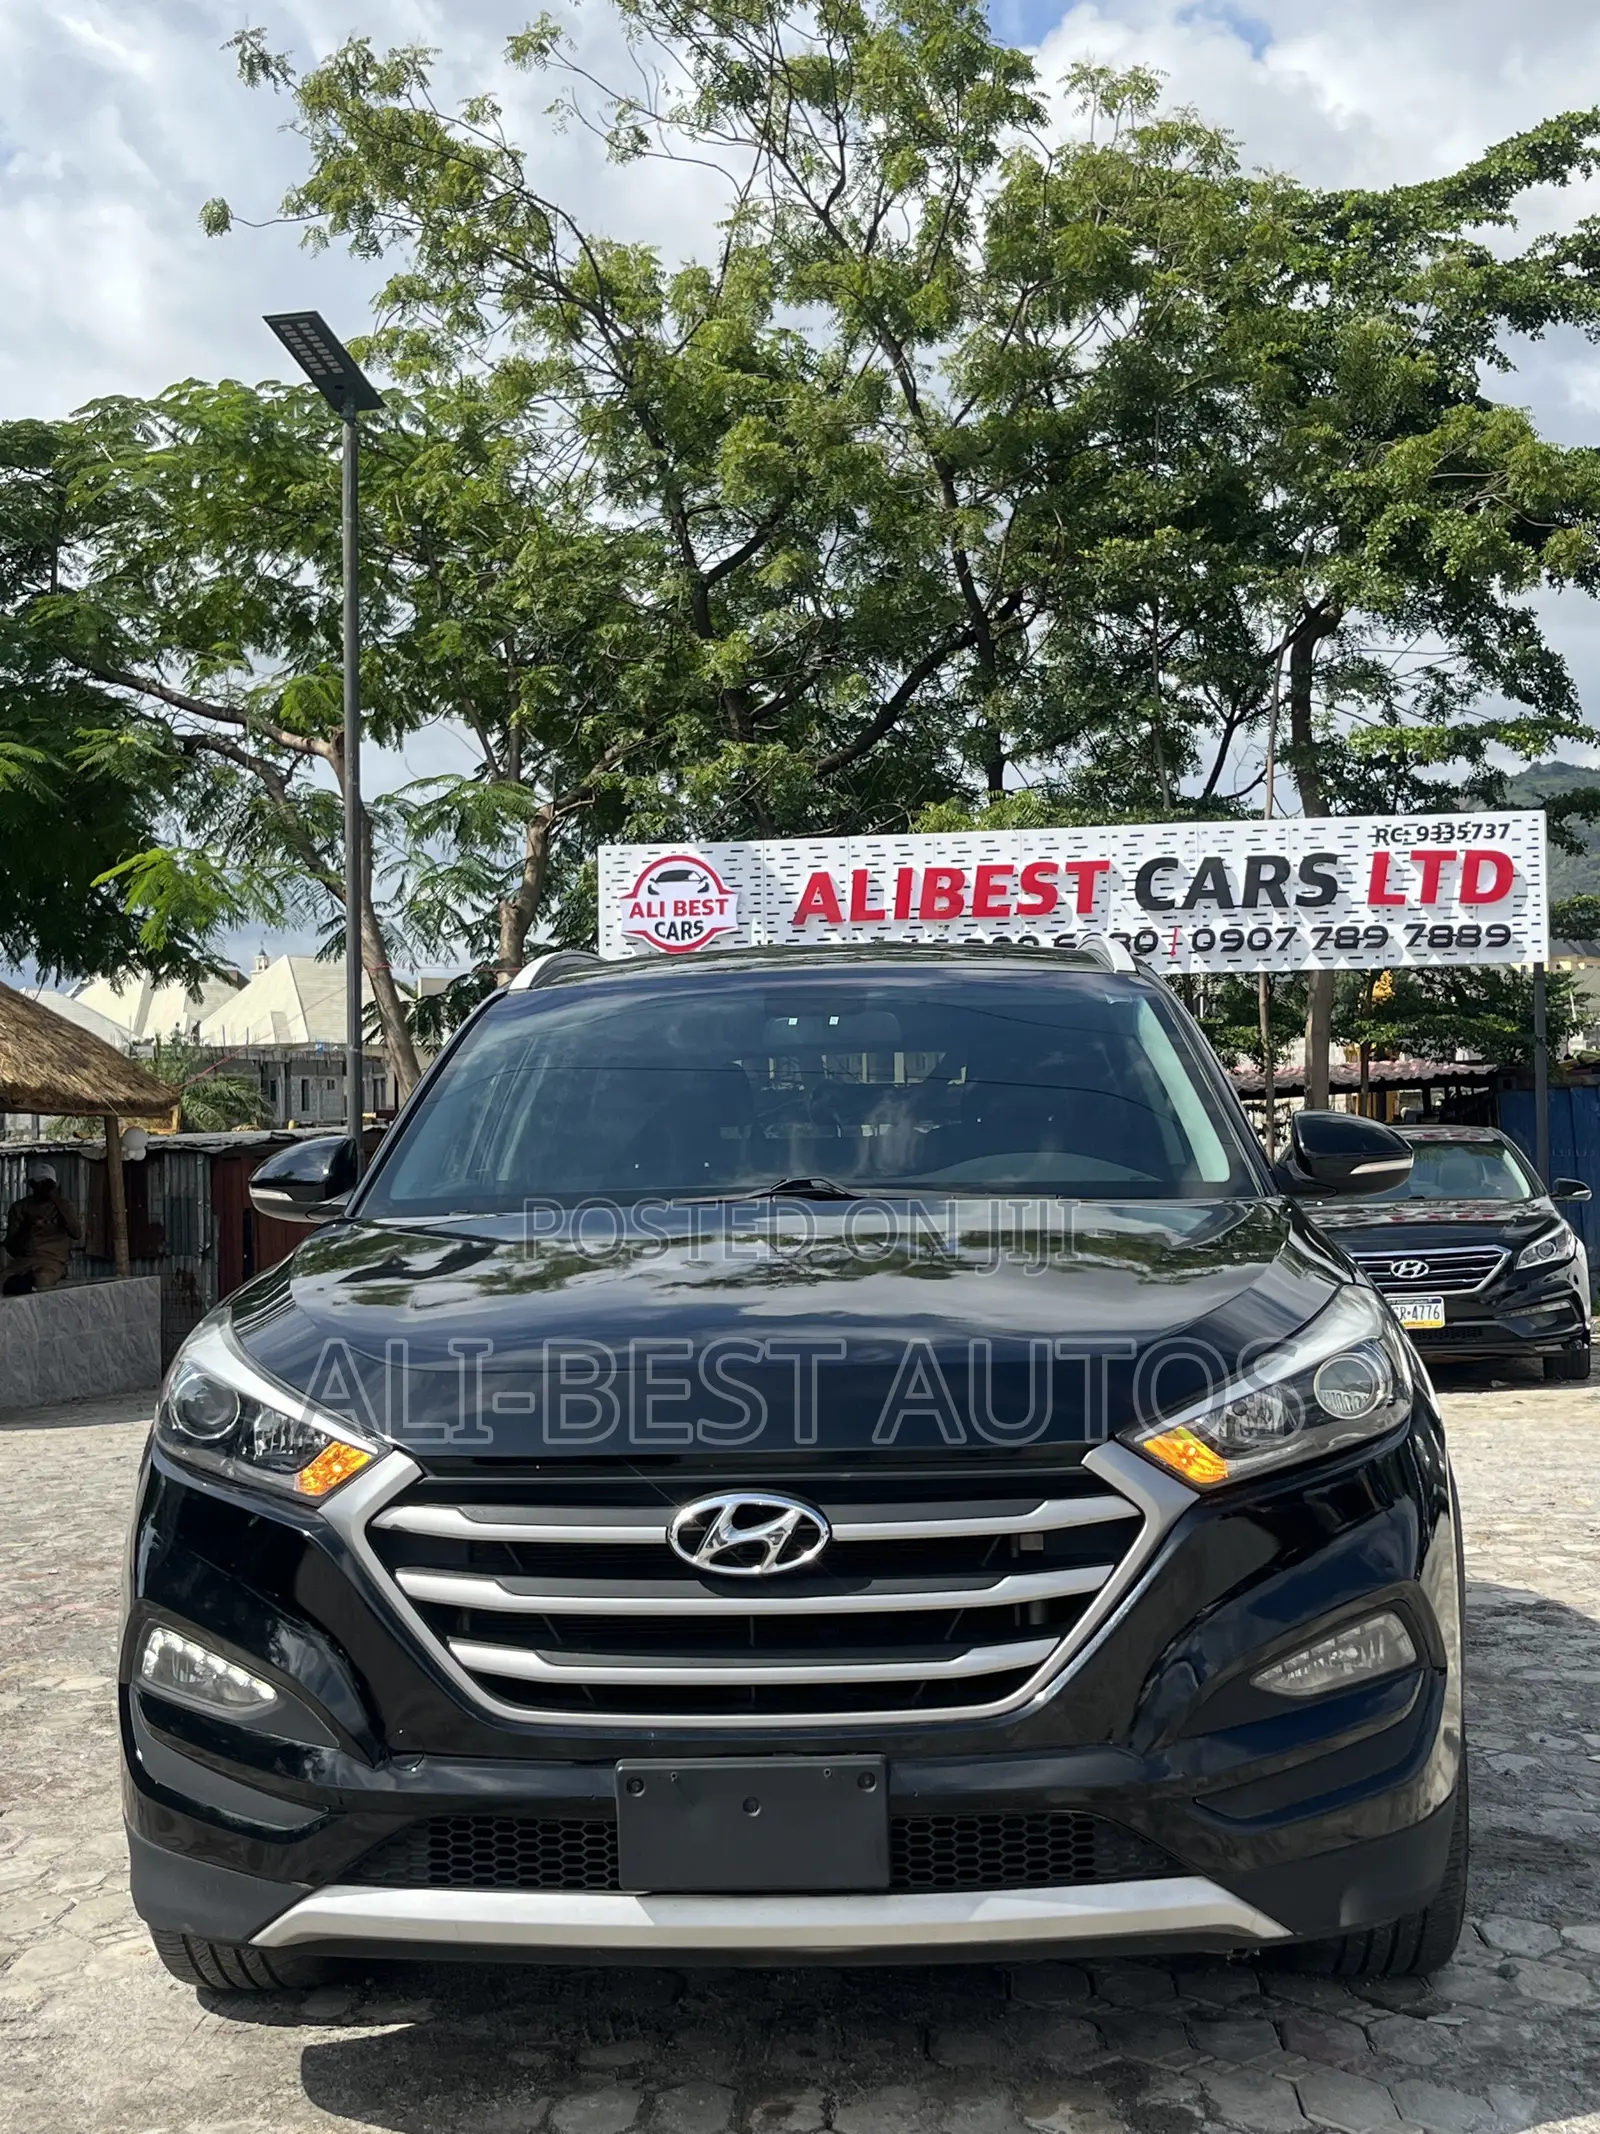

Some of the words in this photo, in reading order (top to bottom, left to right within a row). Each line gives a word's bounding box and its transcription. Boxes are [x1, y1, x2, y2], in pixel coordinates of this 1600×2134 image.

[1416, 823, 1510, 843] 9335737
[792, 860, 1110, 926] ALIBEST
[1134, 852, 1338, 911] CARS
[1367, 849, 1514, 906] LTD
[629, 901, 666, 919] ALI
[673, 898, 729, 917] BEST
[654, 919, 705, 941] CARS
[1191, 928, 1297, 953] 0907
[1312, 926, 1389, 952] 789
[1405, 923, 1512, 948] 7889
